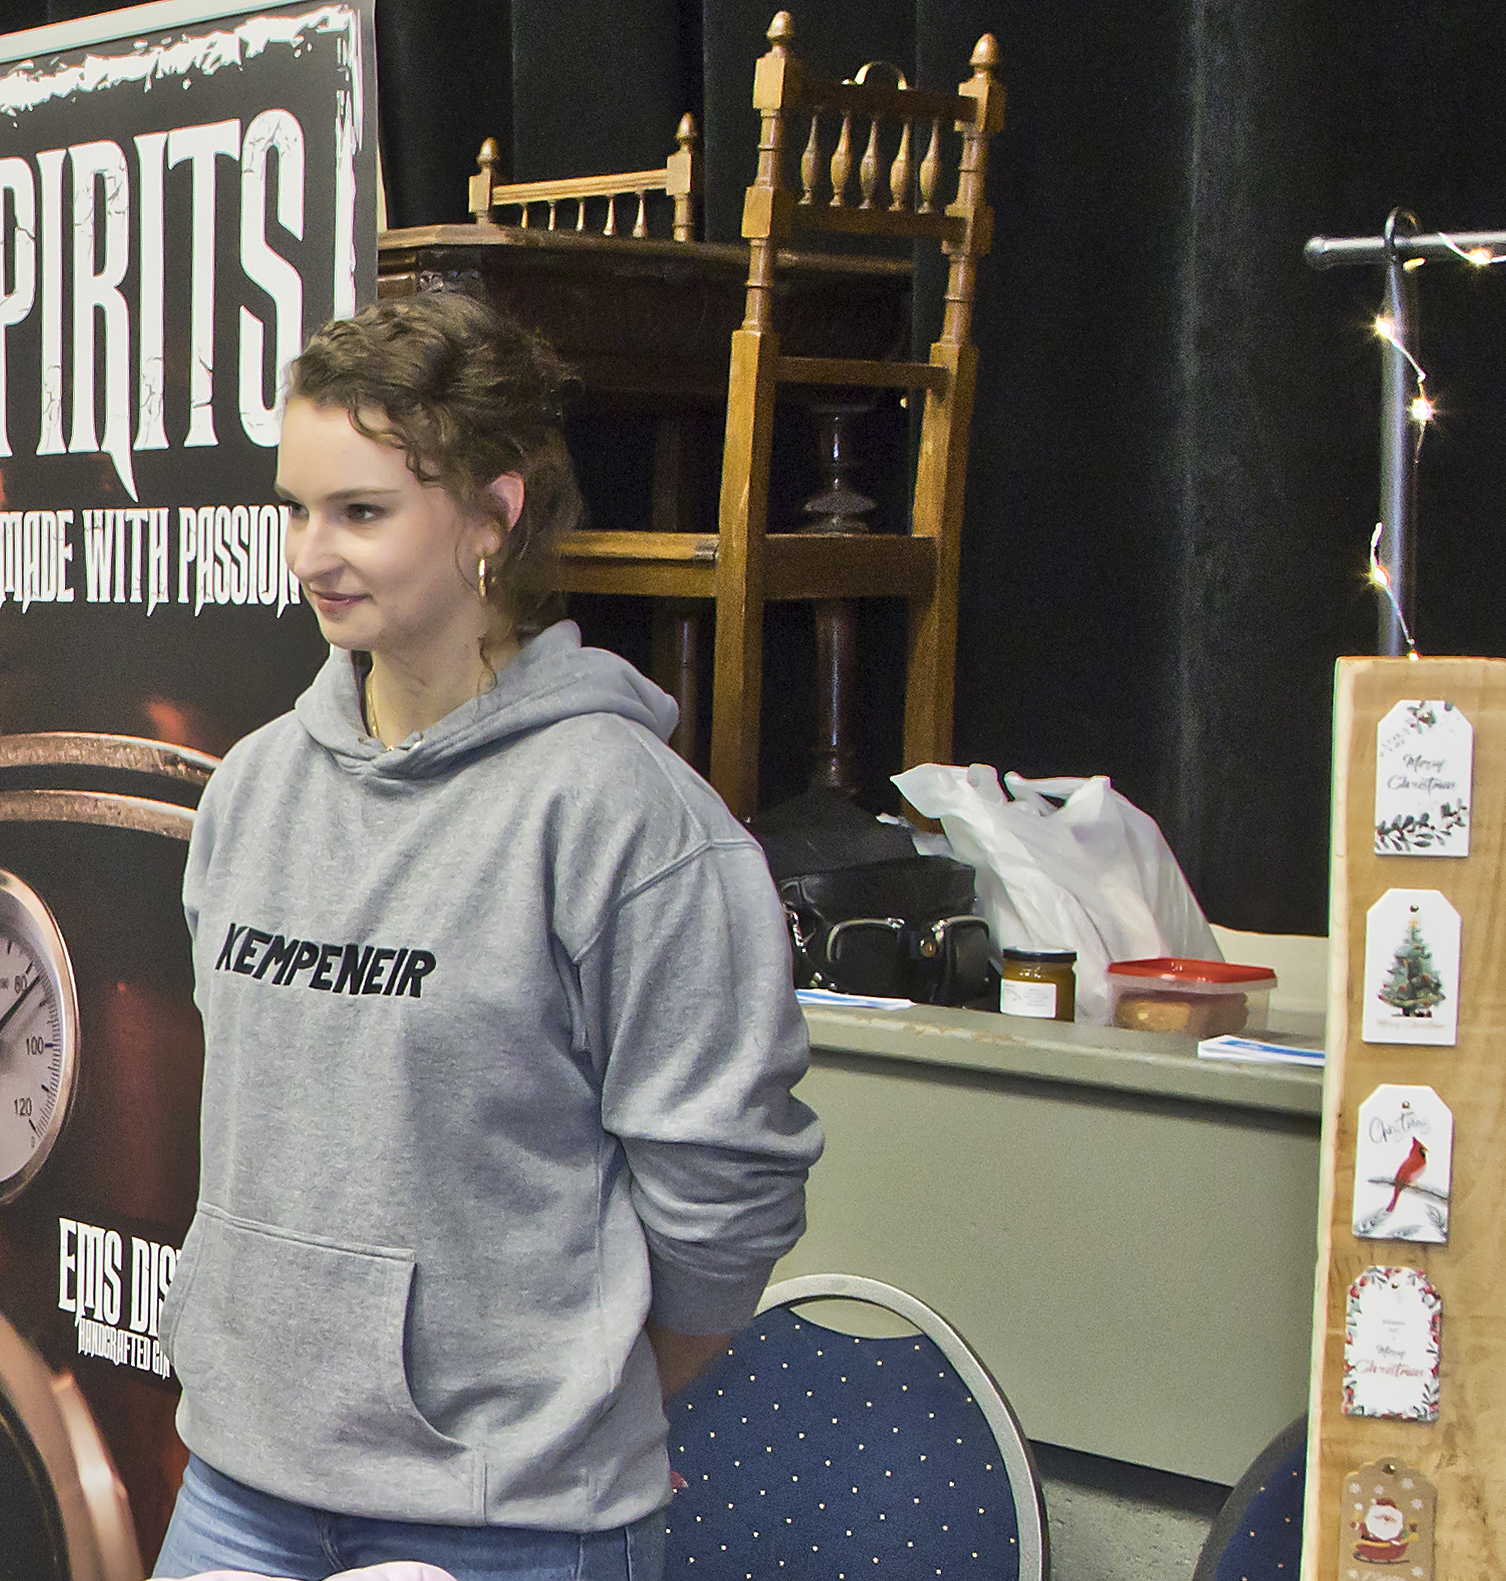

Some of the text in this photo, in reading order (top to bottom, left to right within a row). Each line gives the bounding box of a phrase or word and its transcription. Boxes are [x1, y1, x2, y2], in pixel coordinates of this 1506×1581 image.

[84, 508, 170, 616] WITH
[214, 922, 437, 999] KEMPENEIR
[25, 1036, 45, 1056] 100
[13, 1096, 33, 1117] 120
[58, 1217, 182, 1337] EMS DIS
